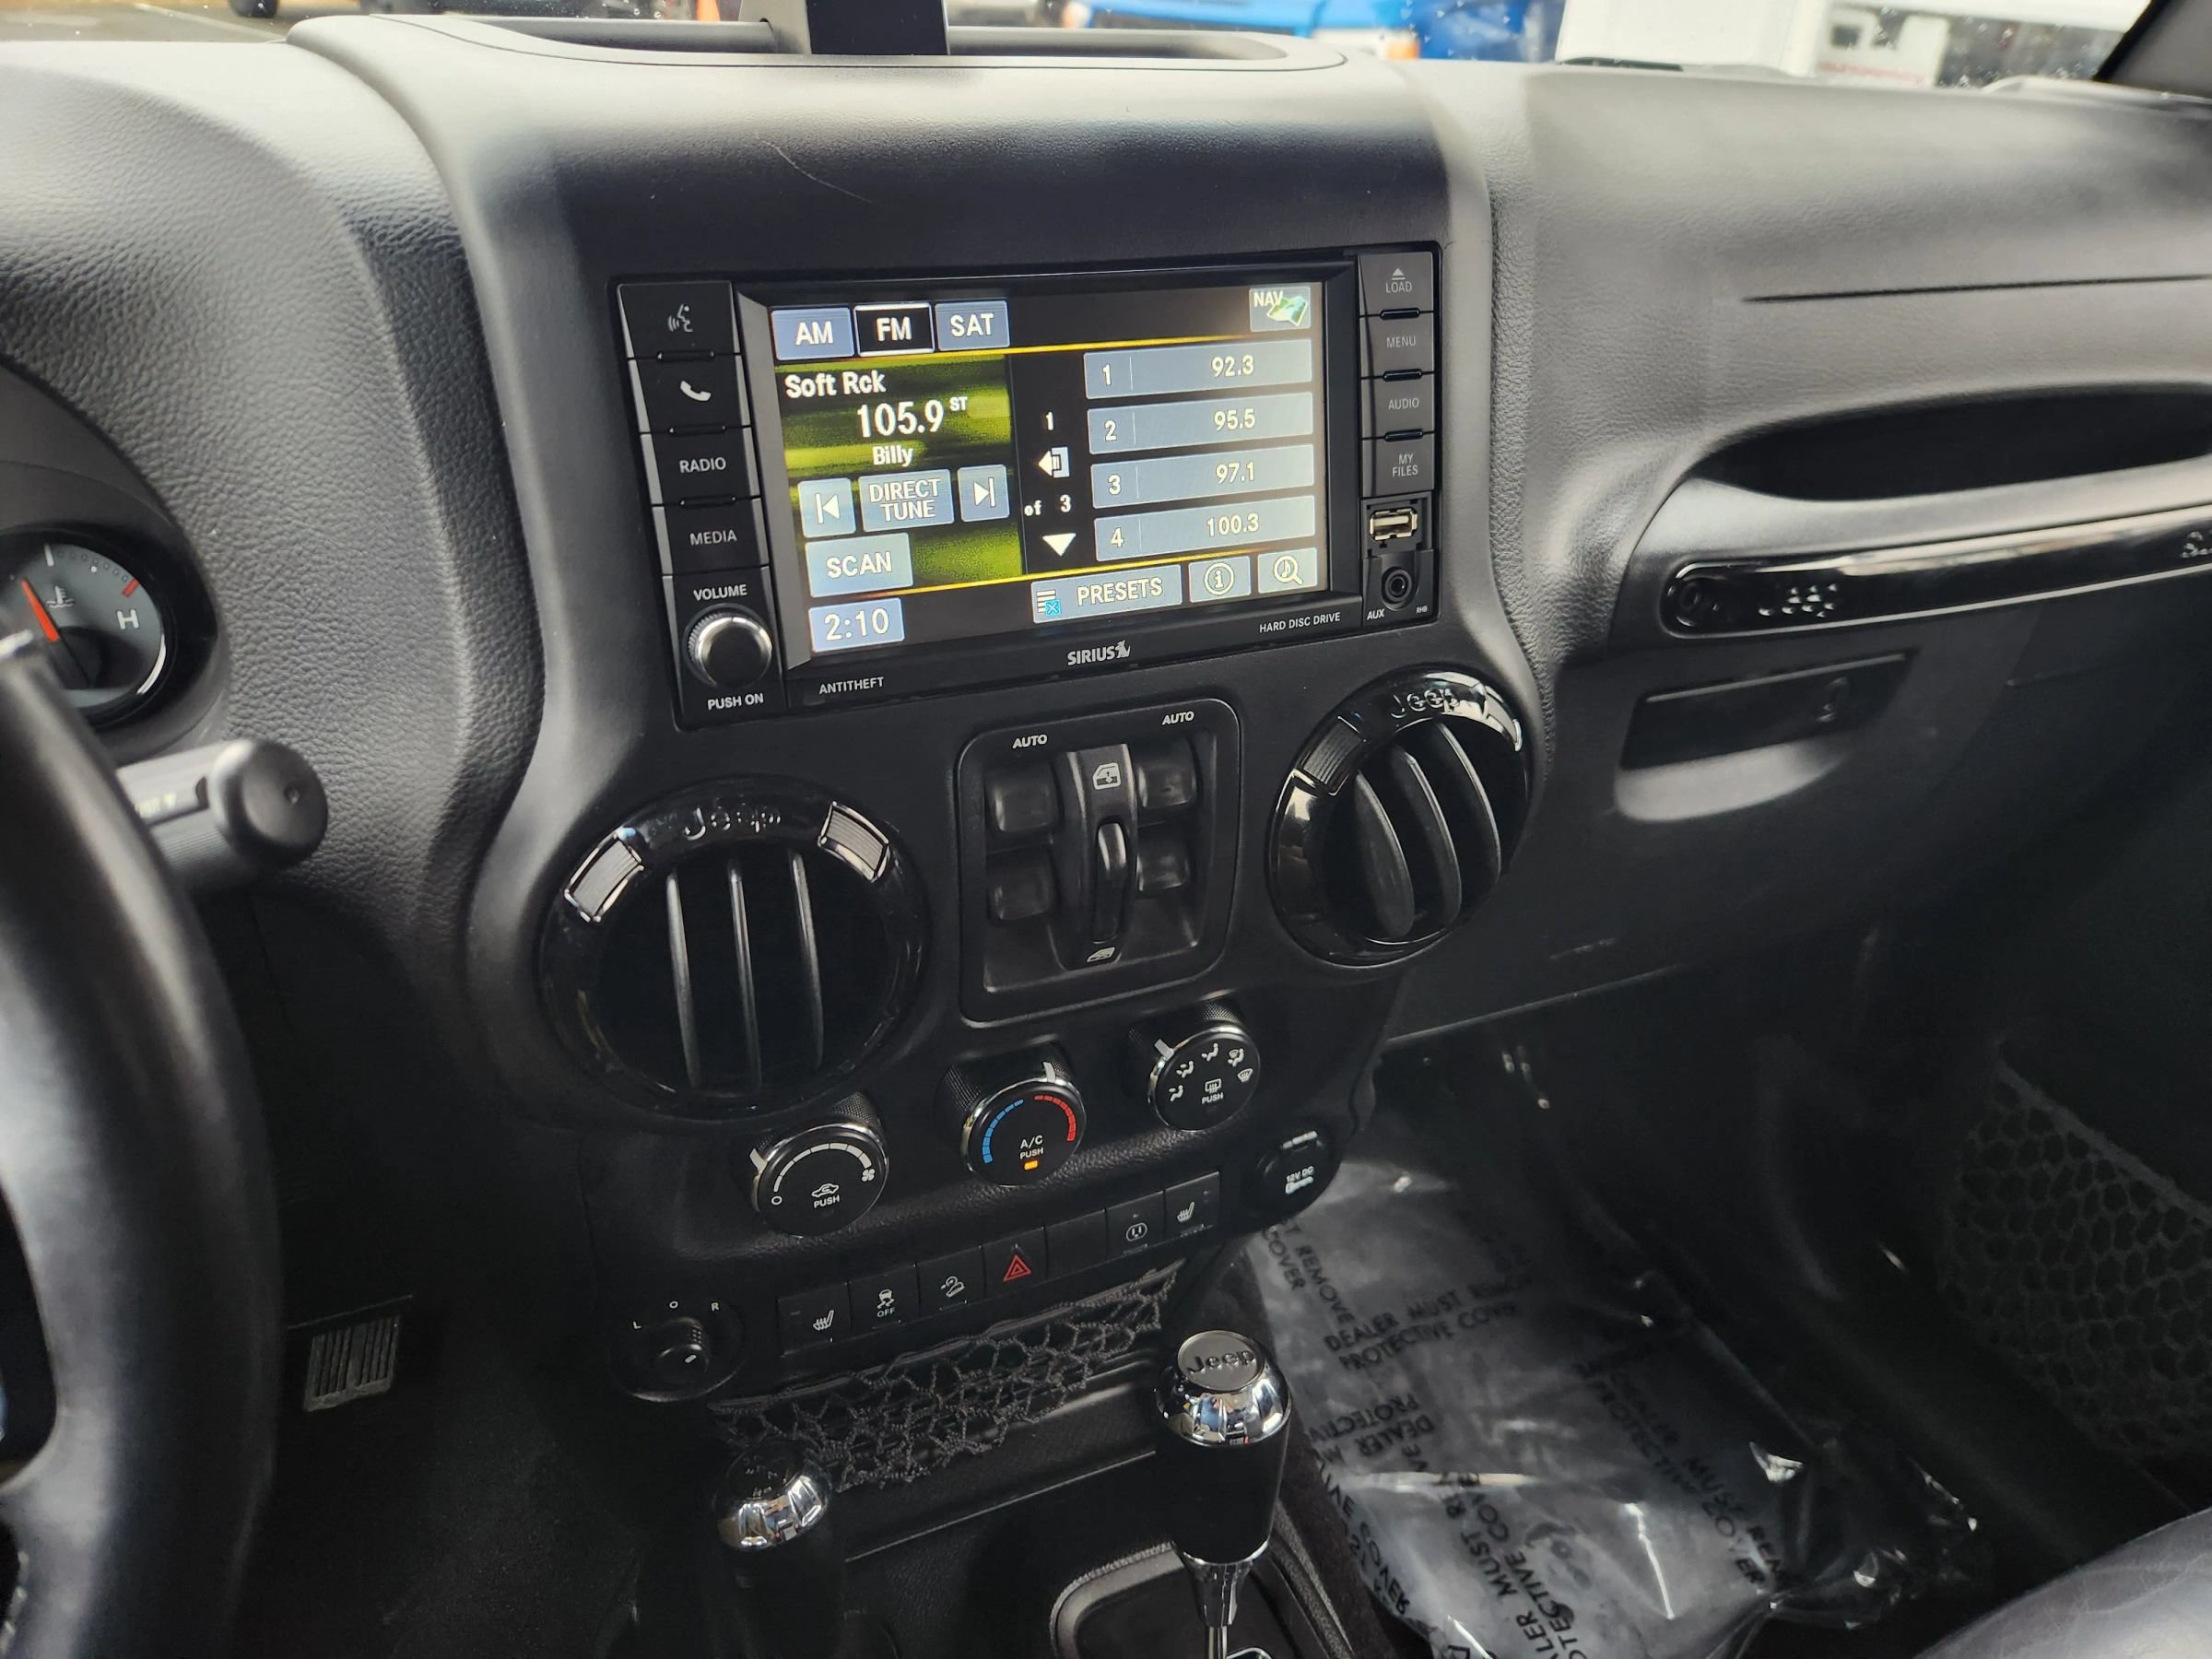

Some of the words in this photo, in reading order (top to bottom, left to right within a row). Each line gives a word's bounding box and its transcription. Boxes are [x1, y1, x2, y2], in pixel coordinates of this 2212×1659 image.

[1385, 280, 1412, 293] LOAD
[1253, 290, 1283, 307] NAV
[795, 321, 834, 346] AM
[877, 316, 912, 341] FM
[949, 313, 994, 338] SAT
[1386, 335, 1416, 348] MENU
[1102, 364, 1112, 386] 1
[1211, 355, 1254, 376] 92.3
[784, 371, 837, 399] Soft
[842, 370, 887, 395] Rck
[1388, 396, 1419, 409] AUDIO
[856, 400, 945, 438] 105.9
[949, 396, 968, 412] ST
[1044, 411, 1053, 431] 1
[1104, 420, 1117, 441] 2
[1214, 409, 1256, 430] 95.5
[679, 456, 727, 474] RADIO
[872, 446, 913, 467] Billy
[1398, 453, 1414, 465] MY
[1108, 475, 1121, 496] 3
[1216, 462, 1254, 484] 97.1
[1392, 464, 1418, 477] FILES
[868, 478, 941, 503] DIRECT
[881, 500, 935, 522] TUNE
[1024, 500, 1041, 516] of
[1060, 495, 1071, 512] 3
[689, 529, 737, 547] MEDIA
[1111, 526, 1124, 548] 4
[1206, 513, 1260, 538] 100.3
[826, 551, 892, 579] SCAN
[693, 584, 747, 601] VOLUME
[1077, 577, 1163, 606] PRESETS
[116, 609, 140, 630] H
[824, 607, 889, 641] 2:10
[1259, 621, 1286, 633] HARD
[1288, 617, 1312, 629] DISC
[1312, 612, 1341, 626] DRIVE
[1366, 608, 1385, 621] AUX
[1067, 645, 1116, 666] SIRIUS
[818, 677, 885, 695] ANTITHEFT
[707, 695, 742, 712] PUSH
[745, 693, 764, 706] ON
[1390, 688, 1461, 719] Jeep
[1161, 711, 1194, 725] AUTO
[1012, 734, 1048, 749] AUTO
[1202, 1092, 1224, 1104] PUSH
[1019, 1135, 1044, 1149] A/C
[1019, 1147, 1043, 1159] PUSH
[1287, 1171, 1301, 1182] 12V
[813, 1194, 840, 1209] PUSH
[711, 1301, 720, 1312] R
[877, 1307, 896, 1318] OFF
[1324, 1312, 1400, 1353] DEALER
[1187, 1349, 1255, 1373] Jeep
[1460, 1534, 1516, 1596] MUST
